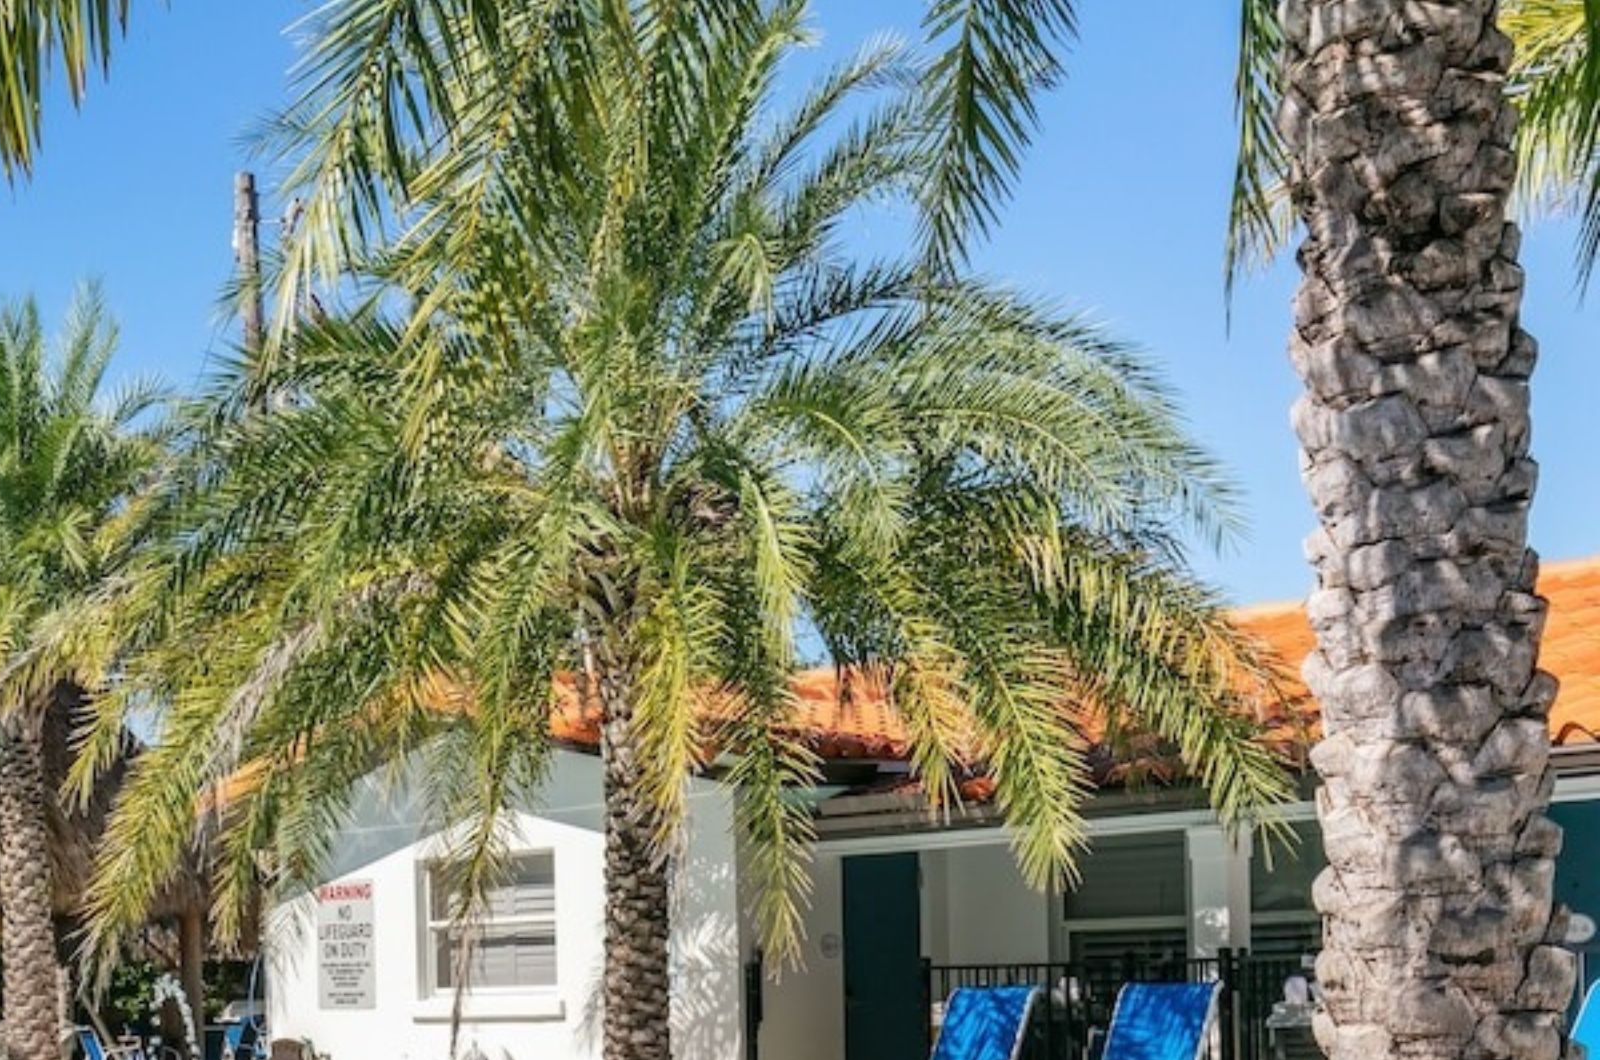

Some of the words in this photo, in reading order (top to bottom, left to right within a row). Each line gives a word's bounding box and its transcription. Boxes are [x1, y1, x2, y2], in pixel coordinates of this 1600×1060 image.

[319, 884, 372, 900] WARNING
[338, 904, 352, 921] NO
[319, 923, 373, 940] LIFEGUARD
[324, 942, 338, 958] ON
[341, 941, 367, 958] DUTY
